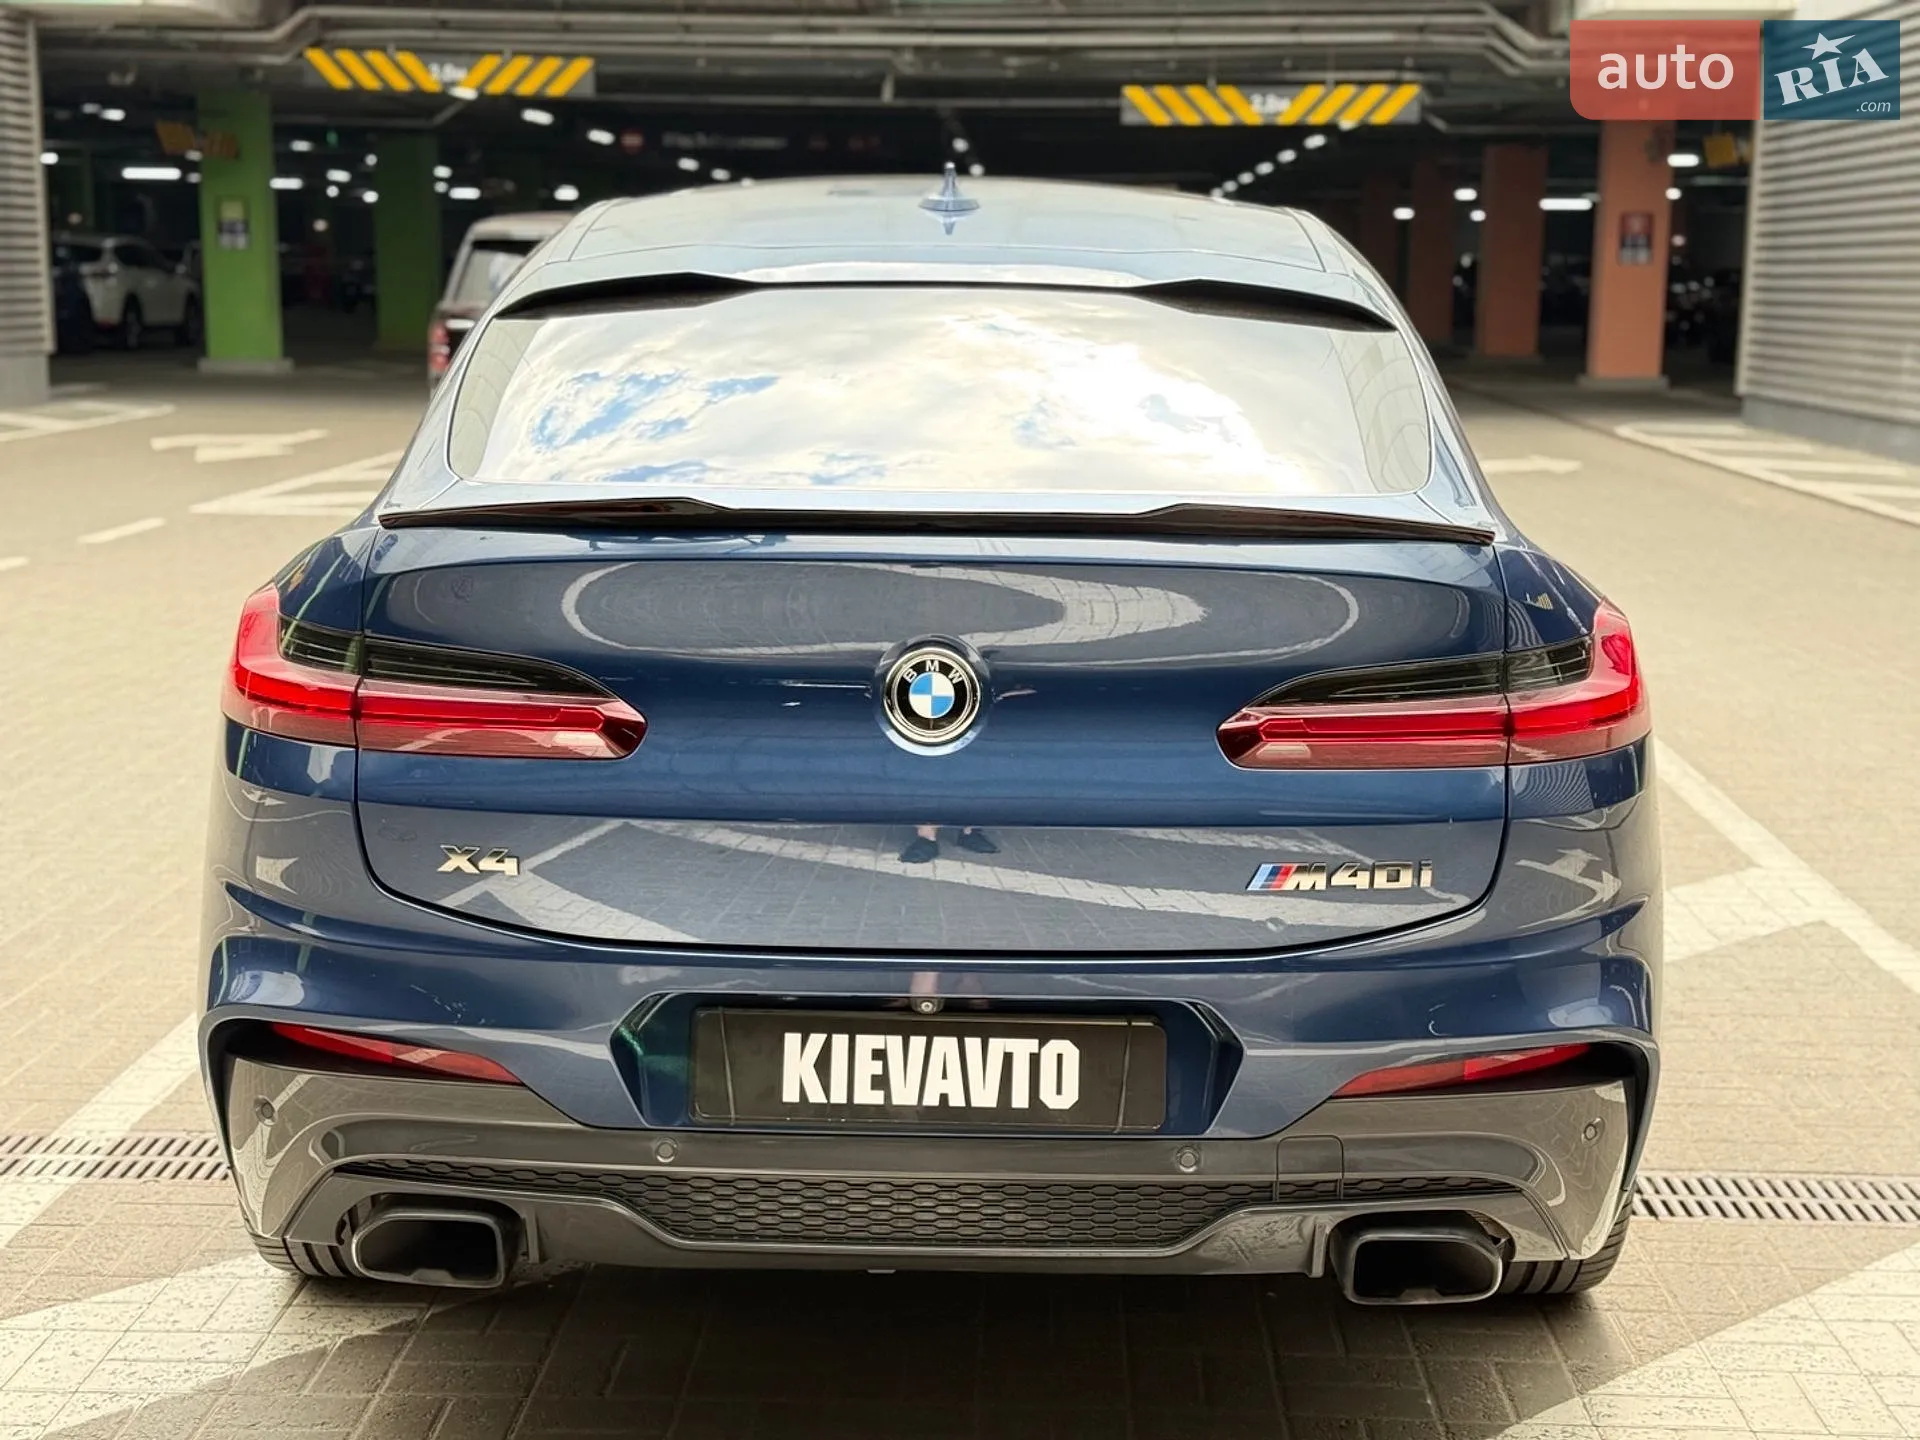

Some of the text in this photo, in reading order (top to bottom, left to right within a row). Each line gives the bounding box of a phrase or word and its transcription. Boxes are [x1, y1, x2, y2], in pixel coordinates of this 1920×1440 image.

[902, 659, 964, 684] BMW
[436, 845, 519, 876] X4
[1282, 860, 1432, 891] M40i
[782, 1031, 1080, 1110] KIEVAVTO
